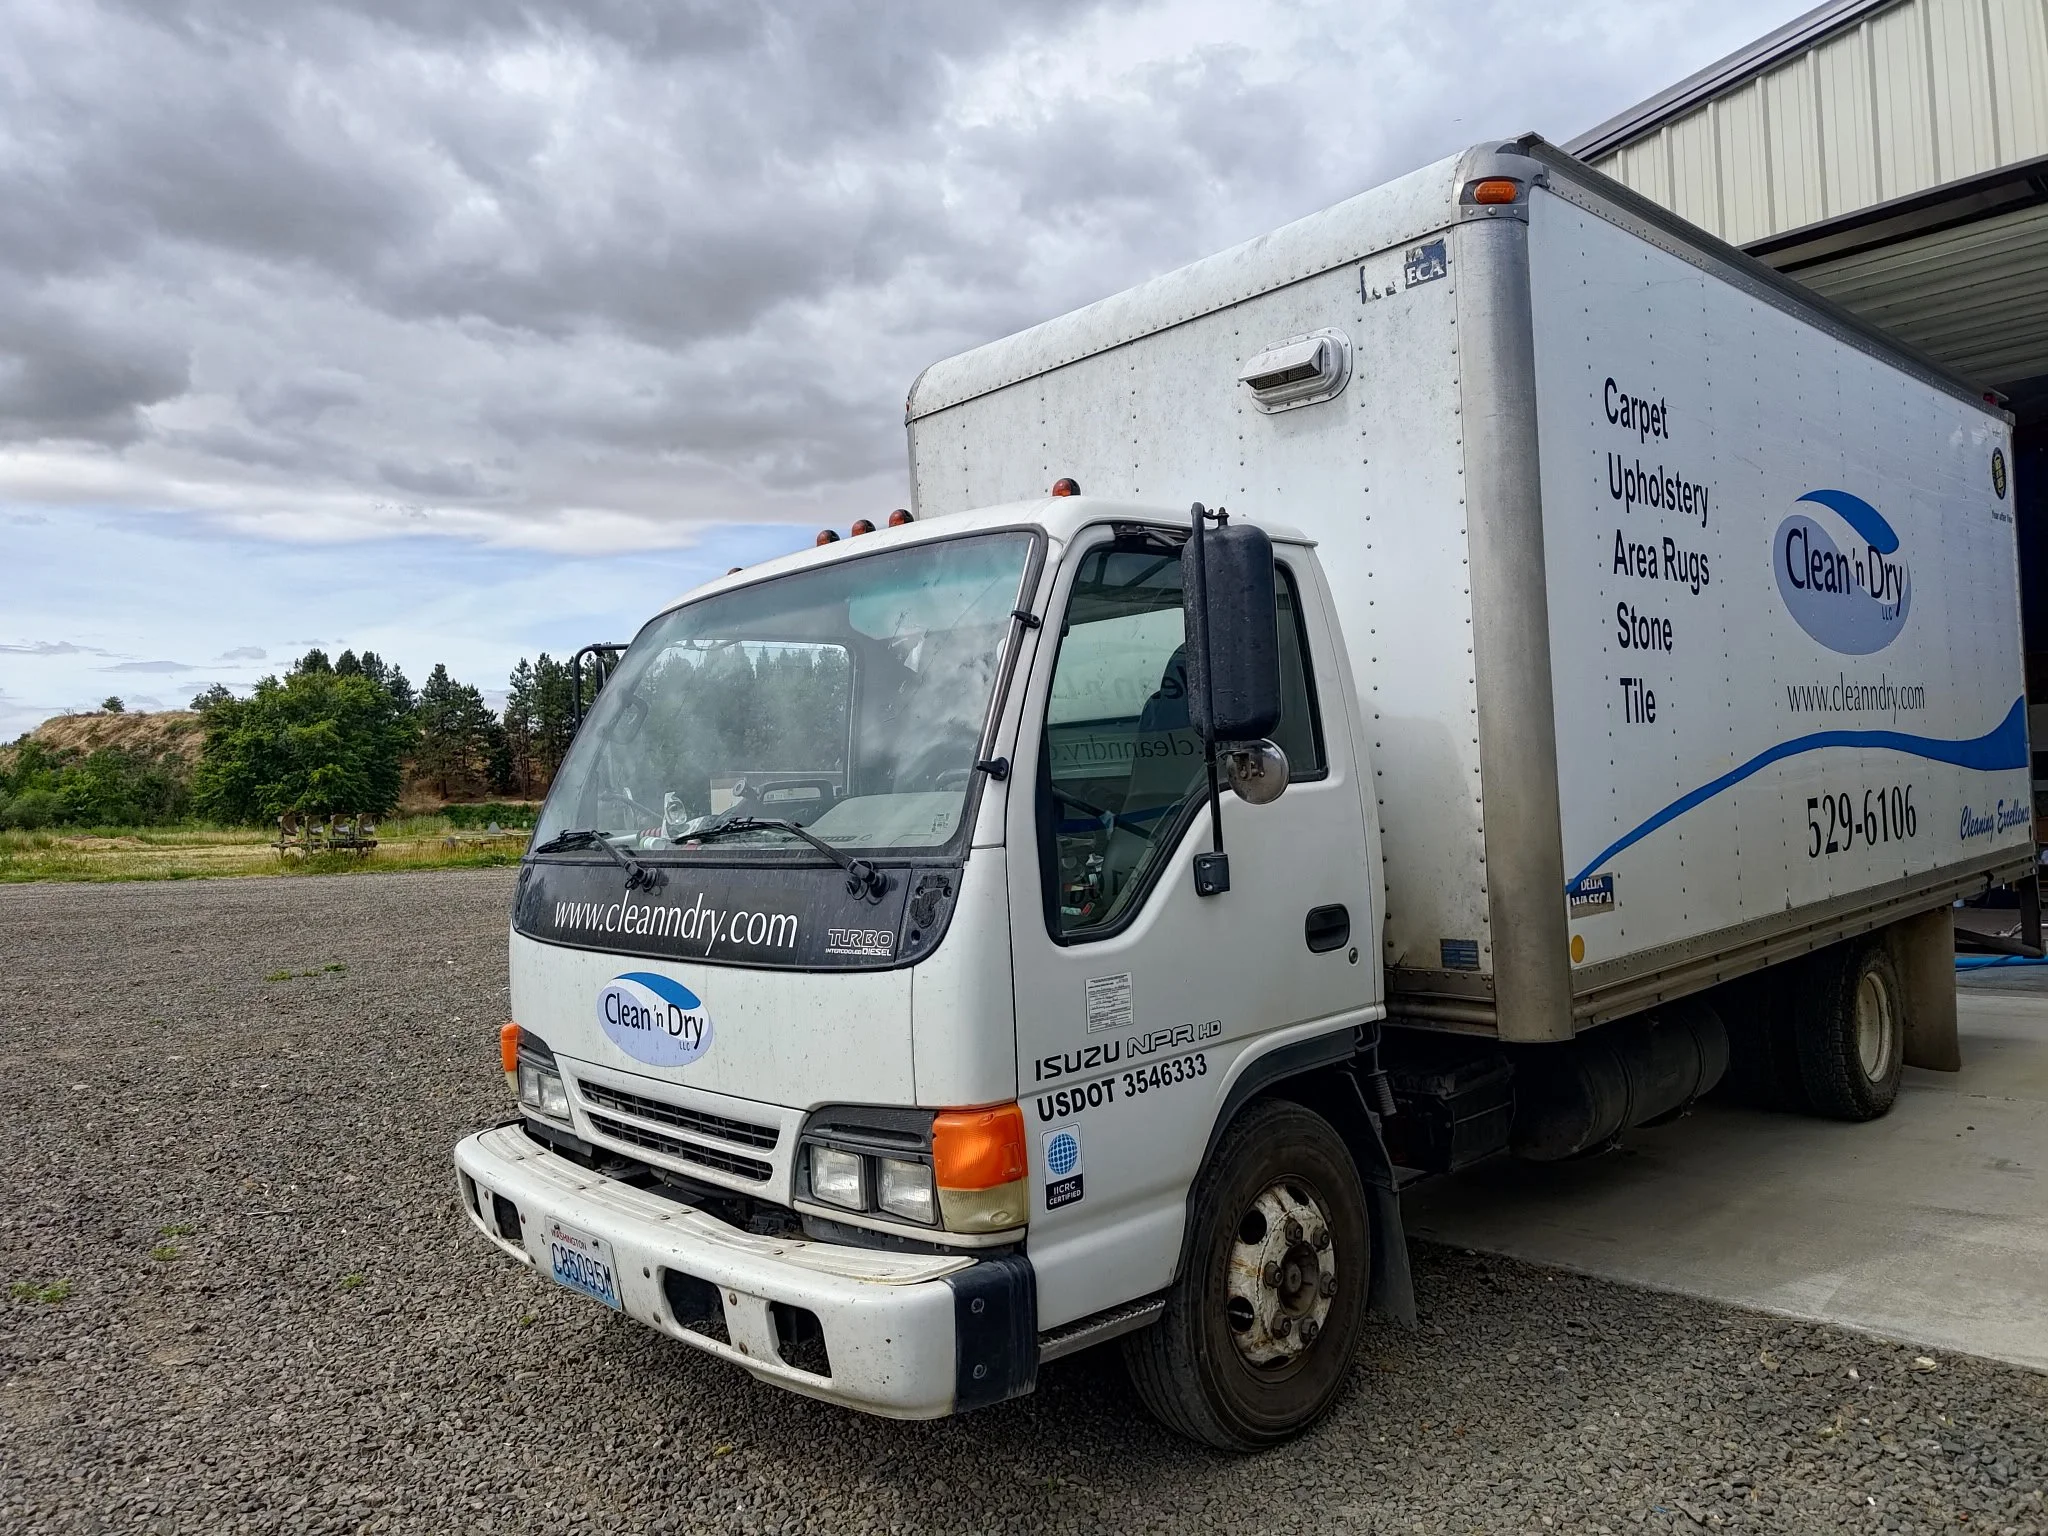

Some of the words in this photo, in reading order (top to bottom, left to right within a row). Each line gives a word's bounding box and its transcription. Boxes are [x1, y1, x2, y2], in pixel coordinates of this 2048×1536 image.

[1604, 377, 1669, 443] Carpet
[1608, 452, 1709, 528] Upholstery
[1613, 528, 1659, 580] Area
[1662, 537, 1710, 596] Rugs
[1785, 526, 1850, 595] Clean
[1867, 545, 1903, 618] Dry
[1617, 602, 1673, 651] Stone
[1881, 605, 1893, 621] LLC
[1620, 677, 1657, 724] Tile
[1787, 671, 1925, 725] www.cleanndry.com
[1806, 783, 1917, 859] 529-6106
[1960, 805, 1994, 844] Cleaning
[554, 889, 799, 956] www.cleanndry.com
[828, 928, 895, 948] TURBO
[862, 948, 892, 957] DIESEL
[604, 993, 651, 1032] Clean
[667, 1003, 704, 1050] Dry
[679, 1040, 690, 1051] LLC
[1035, 1040, 1120, 1082] ISUZU
[1127, 1023, 1195, 1058] NPR
[1199, 1020, 1222, 1040] HD
[1036, 1078, 1116, 1122] USDOT
[1122, 1053, 1208, 1097] 3546333
[1049, 1189, 1082, 1206] CERTIFIED
[1053, 1181, 1076, 1195] IICRC
[551, 1229, 587, 1251] WASHINGTON
[552, 1242, 615, 1300] C85095M
